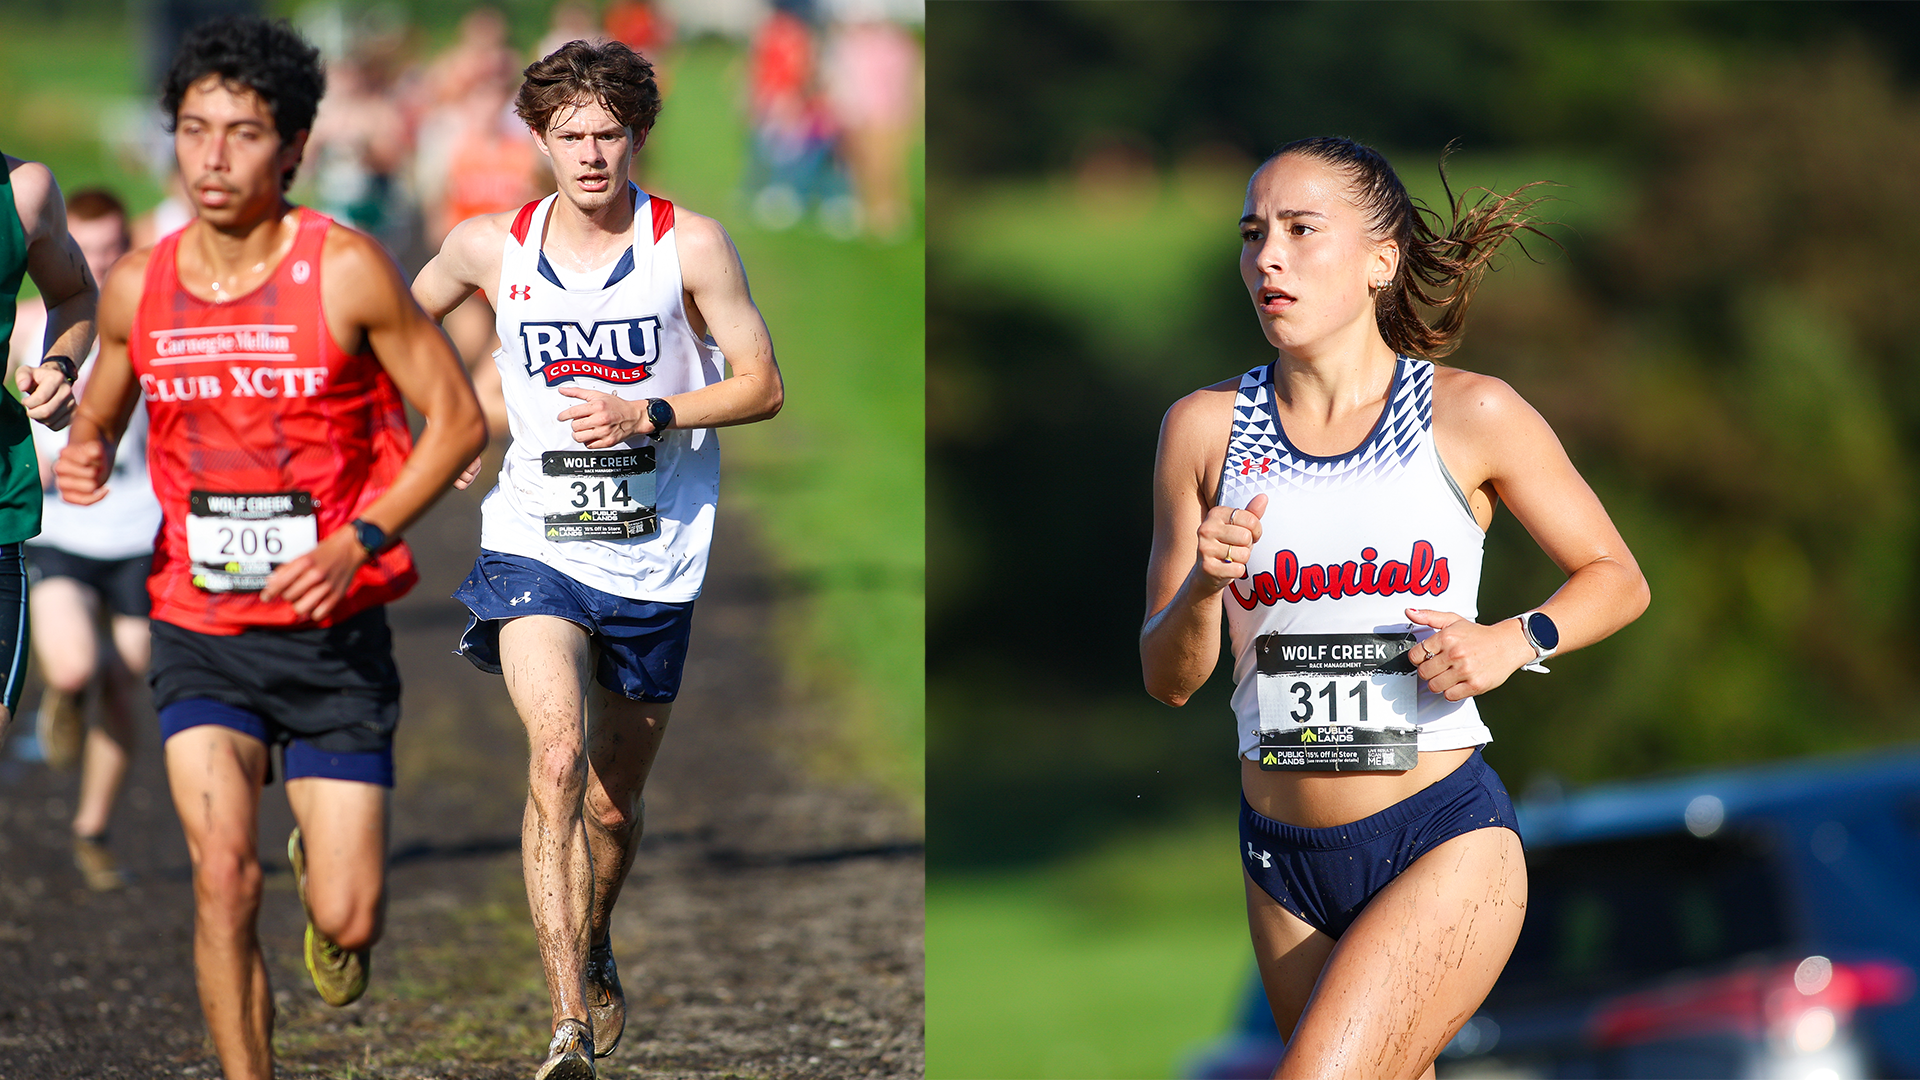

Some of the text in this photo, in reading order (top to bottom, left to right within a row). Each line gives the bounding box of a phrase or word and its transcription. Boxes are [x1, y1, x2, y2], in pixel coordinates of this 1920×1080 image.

[156, 331, 290, 358] Carnegie Mellon
[520, 315, 661, 375] RMU
[550, 364, 641, 380] COLONIALS
[140, 367, 329, 402] CLUB XCTF
[563, 455, 638, 468] WOLF CREEK
[207, 495, 294, 512] WOLF CREEK
[570, 479, 632, 508] 314
[218, 527, 283, 555] 206
[1281, 644, 1387, 661] WOLF CREEK
[1289, 680, 1368, 723] 311
[1317, 734, 1354, 742] LANDS
[1368, 757, 1382, 765] ME
